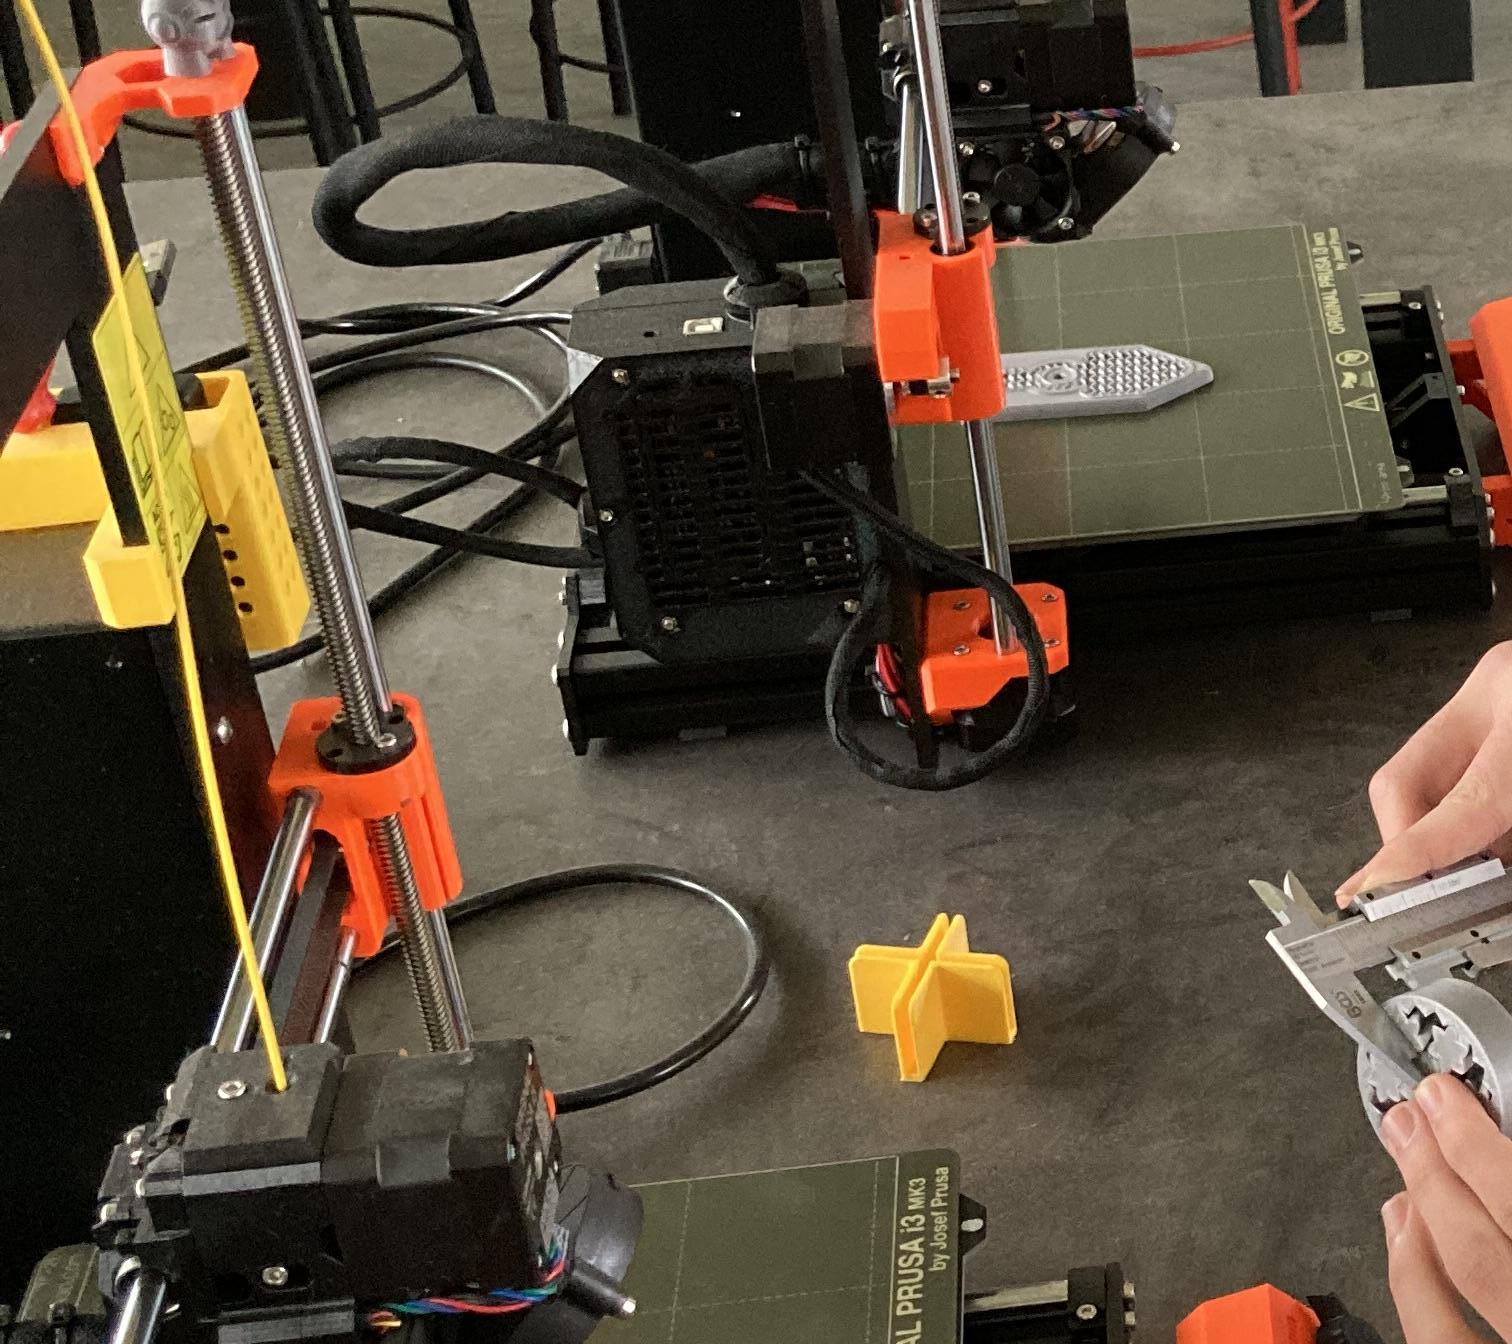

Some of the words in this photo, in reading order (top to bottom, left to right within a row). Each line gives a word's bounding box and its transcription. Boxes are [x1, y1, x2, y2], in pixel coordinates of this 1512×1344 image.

[908, 1177, 926, 1211] MK3
[930, 1166, 949, 1209] Prusa
[899, 1213, 926, 1234] i3
[929, 1212, 948, 1250] Josef
[896, 1236, 925, 1317] PRUSA
[929, 1253, 950, 1272] by
